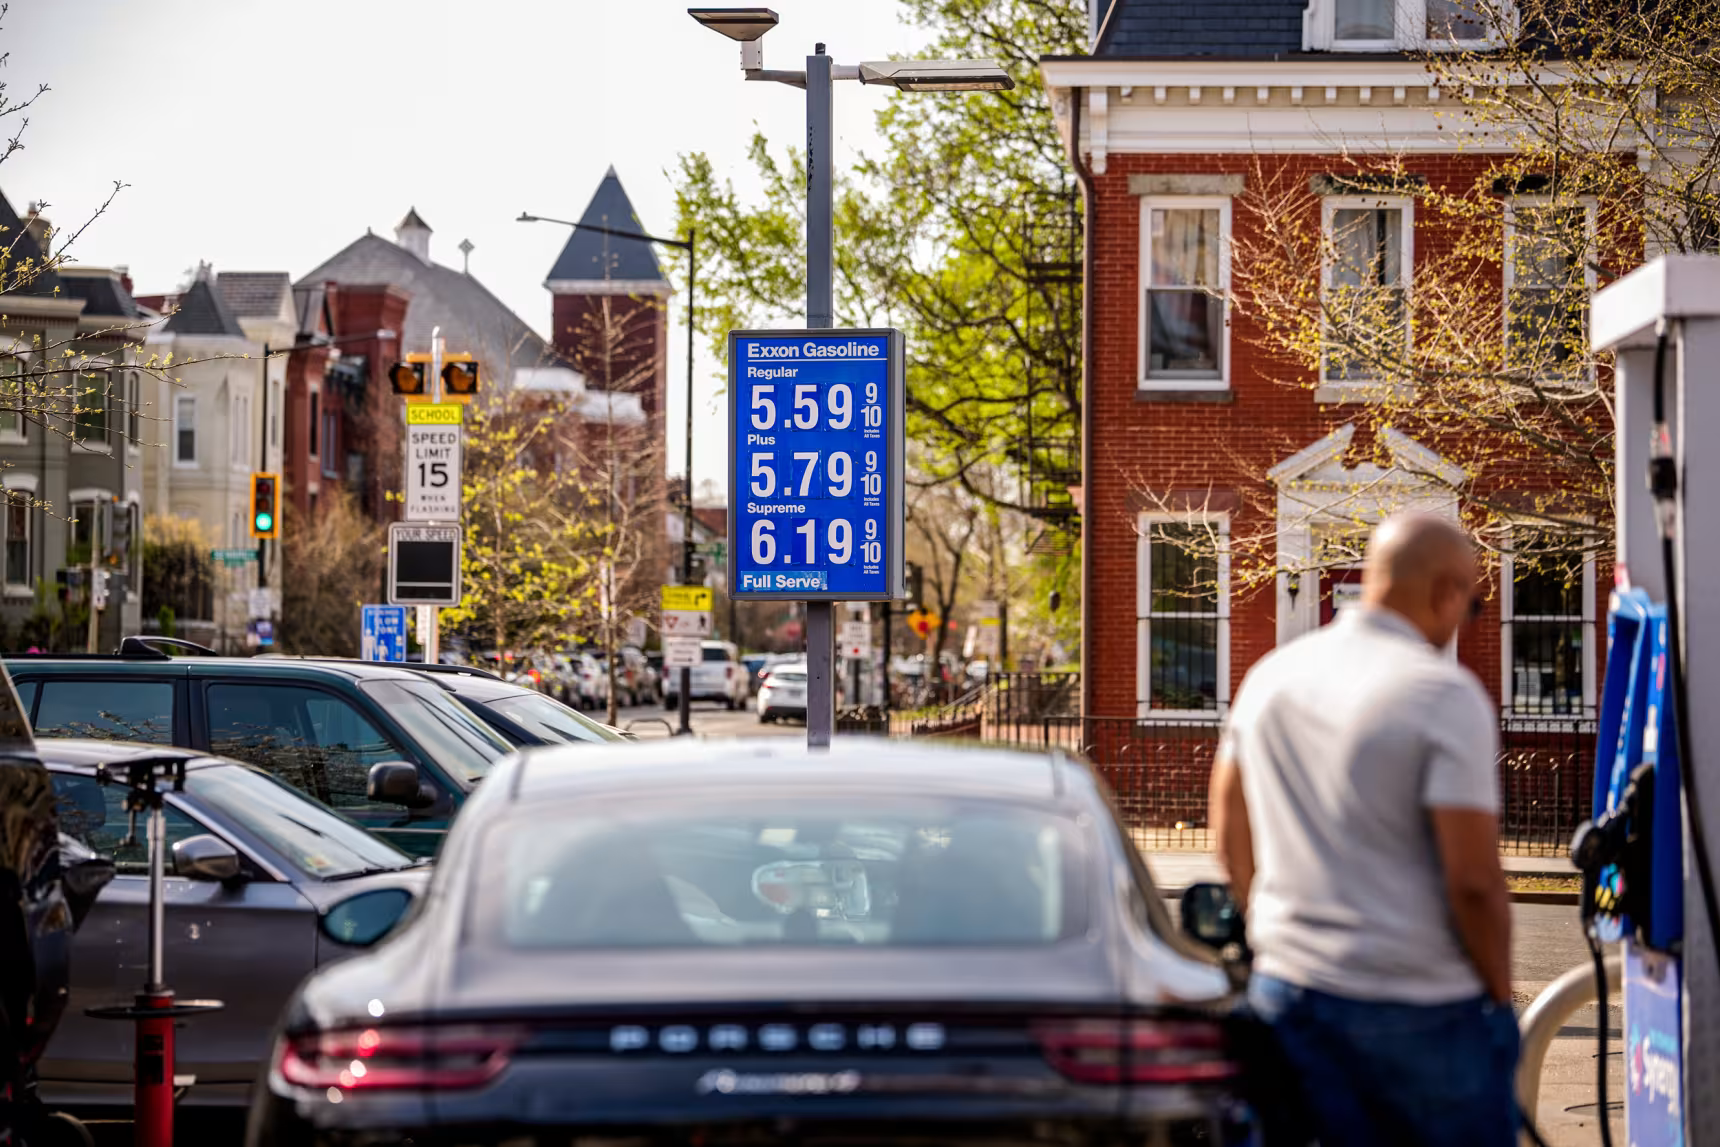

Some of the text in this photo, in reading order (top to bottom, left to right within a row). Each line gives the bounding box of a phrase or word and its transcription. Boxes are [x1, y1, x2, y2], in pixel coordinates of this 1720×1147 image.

[747, 342, 880, 358] Exxon Gasoline
[747, 366, 799, 380] Regular
[864, 382, 878, 404] 9
[411, 409, 456, 421] SCHOOL
[750, 383, 853, 430] 5.59
[860, 405, 882, 427] 10
[411, 432, 457, 445] SPEED
[747, 434, 776, 446] Plus
[416, 447, 451, 459] LIMIT
[864, 450, 878, 472] 9
[418, 462, 449, 488] 15
[750, 451, 853, 498] 5.79
[860, 473, 882, 495] 10
[747, 503, 806, 517] Supreme
[864, 518, 878, 540] 9
[750, 518, 853, 565] 6.19
[859, 541, 882, 563] 10
[743, 574, 821, 589] Full Serve
